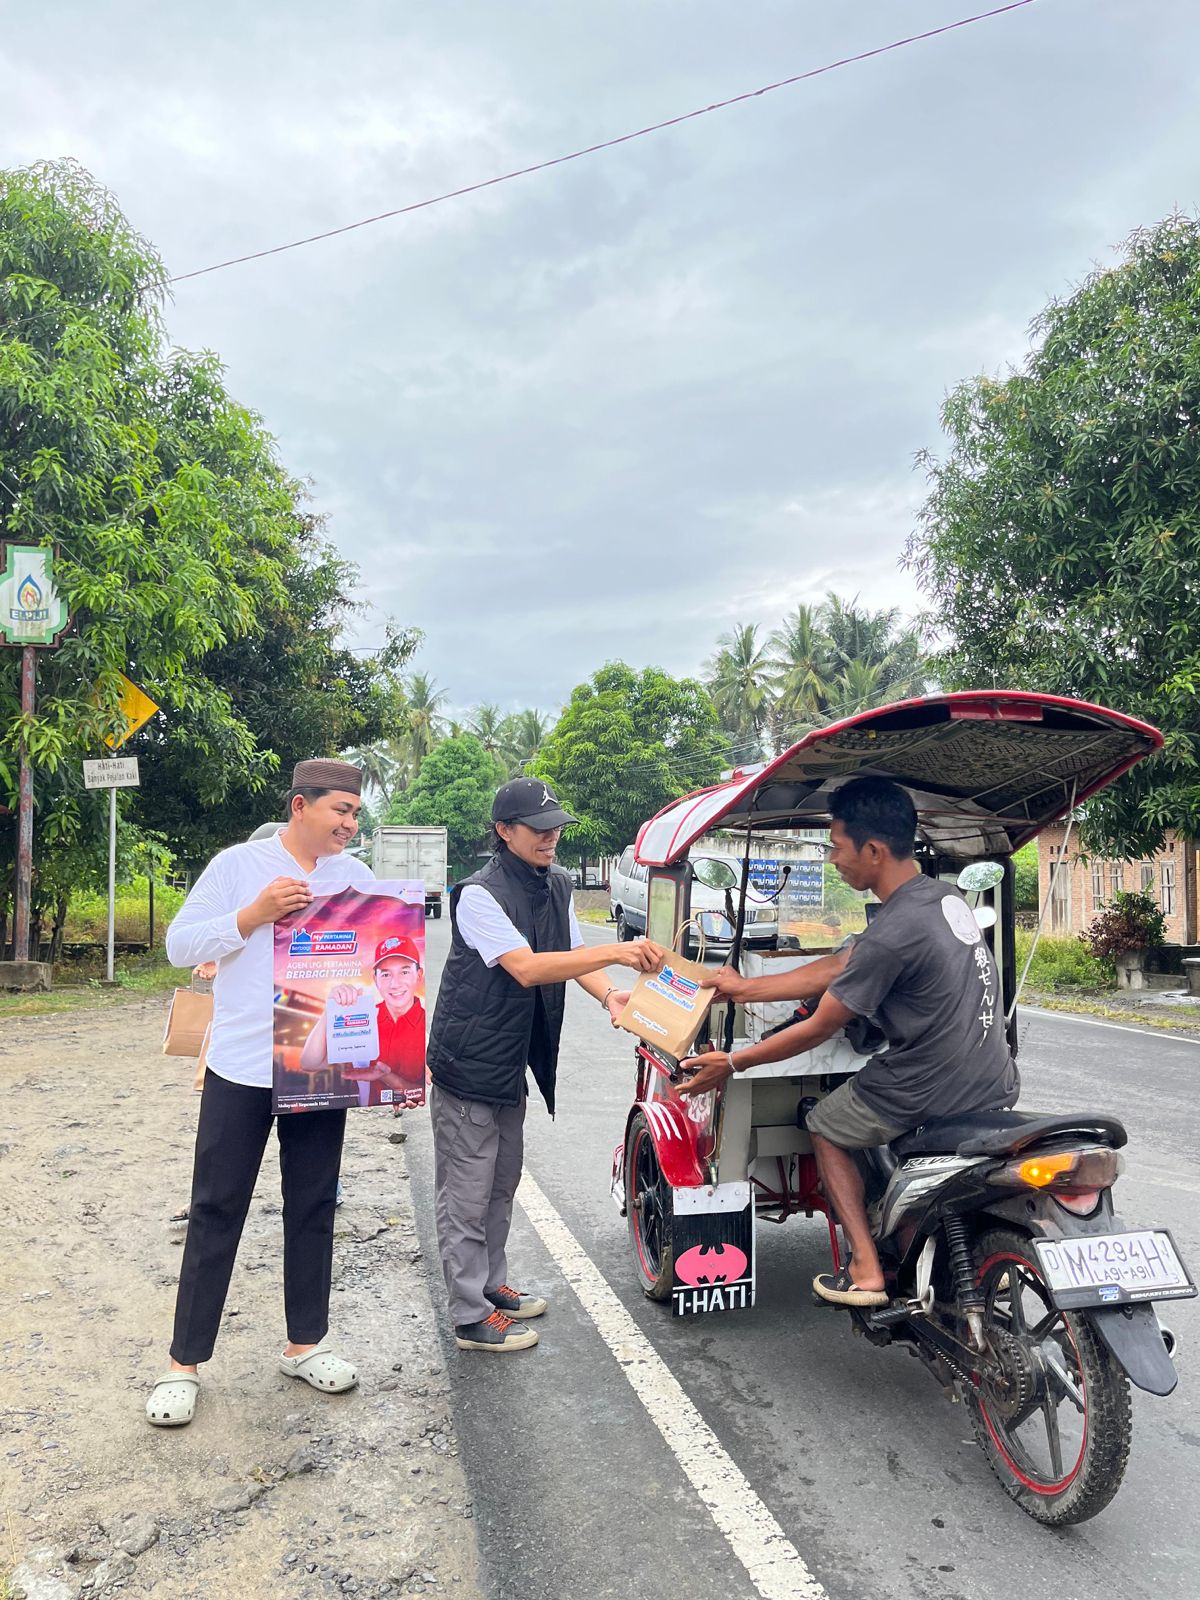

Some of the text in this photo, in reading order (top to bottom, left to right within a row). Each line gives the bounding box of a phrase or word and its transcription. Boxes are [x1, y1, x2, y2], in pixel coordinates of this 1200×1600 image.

[12, 610, 47, 620] ELPIJI
[315, 943, 353, 951] RAMADAN
[287, 961, 362, 970] AGEN LPG PERTAMINA
[286, 969, 362, 979] BERBAGI TAKJIL
[905, 1157, 956, 1169] REVO
